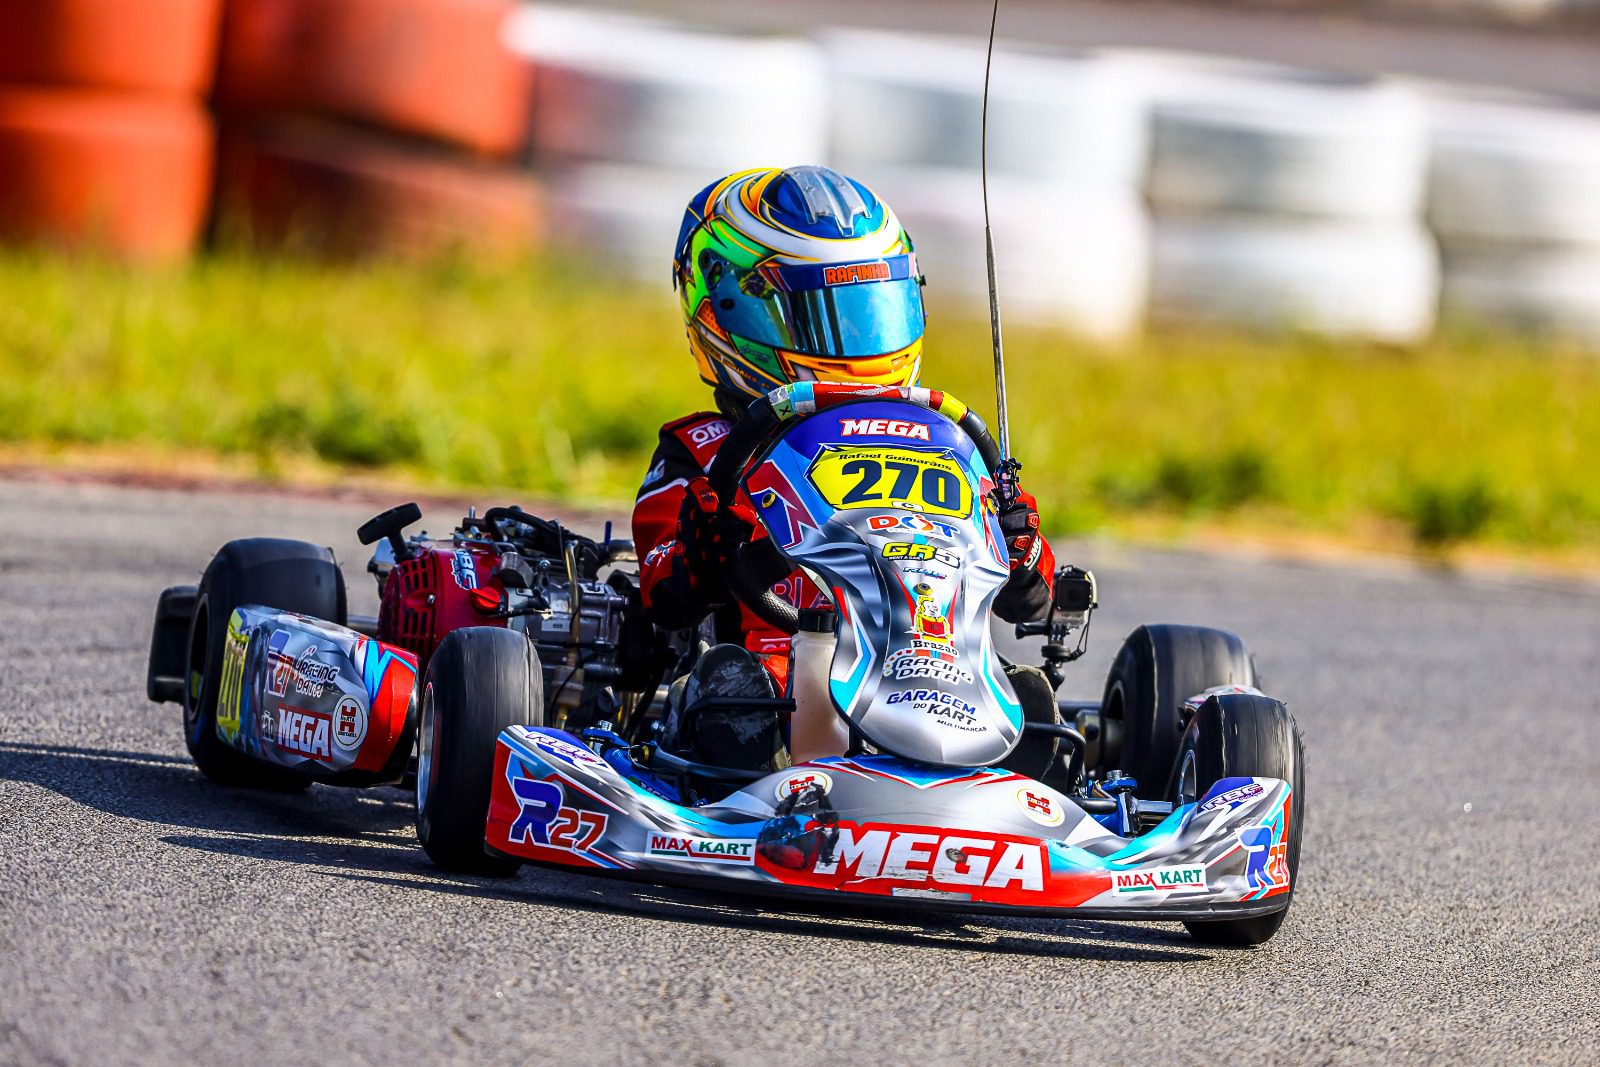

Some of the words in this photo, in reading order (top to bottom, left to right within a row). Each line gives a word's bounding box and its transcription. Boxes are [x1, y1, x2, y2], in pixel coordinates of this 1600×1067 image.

[825, 263, 891, 285] RAFINHA
[840, 418, 930, 441] MEGA
[841, 459, 961, 511] 270
[899, 657, 972, 682] RACING
[899, 668, 959, 683] DATA
[886, 690, 977, 715] GARAGEM
[927, 703, 977, 726] KART
[278, 708, 330, 757] MEGA
[508, 777, 608, 850] R27
[651, 836, 693, 851] MAX
[699, 841, 752, 856] KART
[813, 826, 1045, 892] MEGA
[1117, 872, 1154, 887] MAX
[1160, 870, 1203, 884] KART
